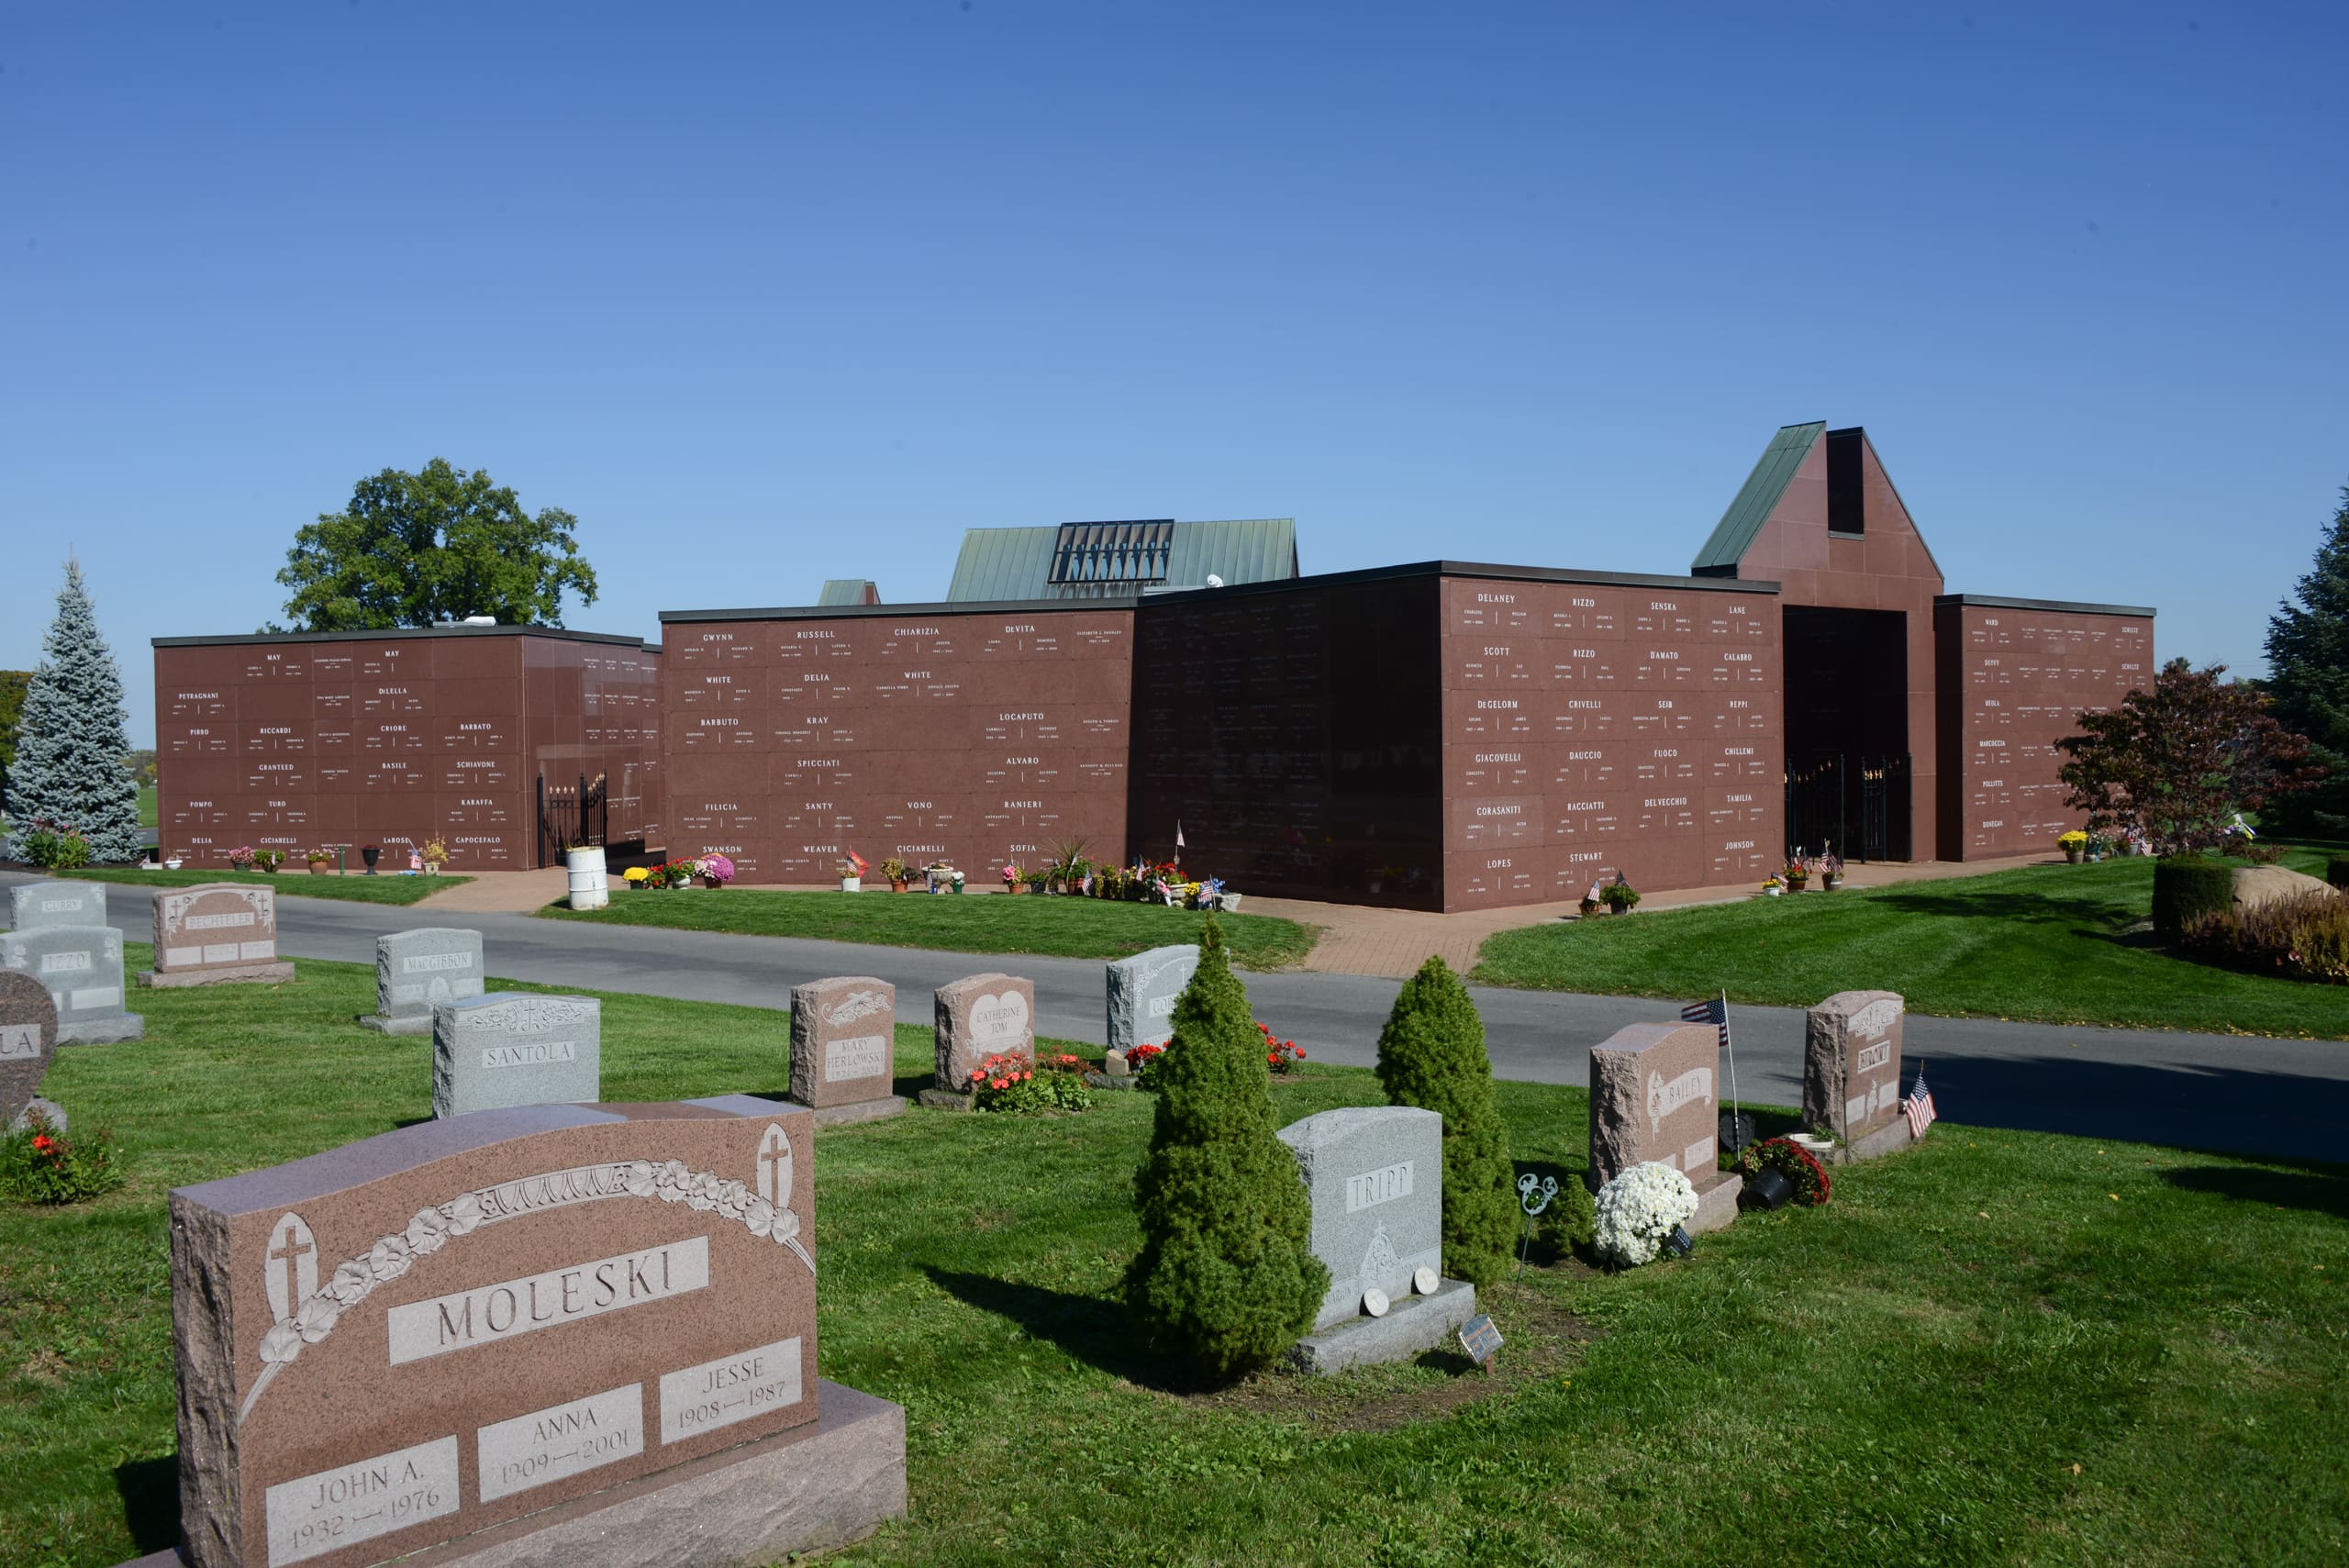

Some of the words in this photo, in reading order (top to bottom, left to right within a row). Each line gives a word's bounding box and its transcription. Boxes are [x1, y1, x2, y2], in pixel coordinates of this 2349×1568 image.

[1478, 594, 1515, 603] DELANEY
[1573, 598, 1594, 606] RIZZO
[1485, 647, 1509, 655] SCOTT
[1475, 753, 1520, 762] GIACOVELLI
[1477, 806, 1520, 816] CORASANITI
[1725, 840, 1753, 850] JOHNSON
[1487, 859, 1511, 868] LOPES
[1570, 852, 1602, 862] STEWART
[189, 913, 251, 929] BECHTELER
[976, 1005, 1021, 1023] CATHERINE
[990, 1021, 1008, 1036] TOM
[841, 1039, 868, 1052] MARY
[487, 1042, 571, 1066] SANTOLA
[1669, 1075, 1701, 1104] BAILEY
[1353, 1166, 1408, 1207] TRIPP
[437, 1249, 675, 1348] MOLESKI
[702, 1356, 765, 1395] JESSE
[532, 1407, 598, 1444] ANNA
[311, 1466, 388, 1510] JOHN
[401, 1460, 425, 1484] A.
